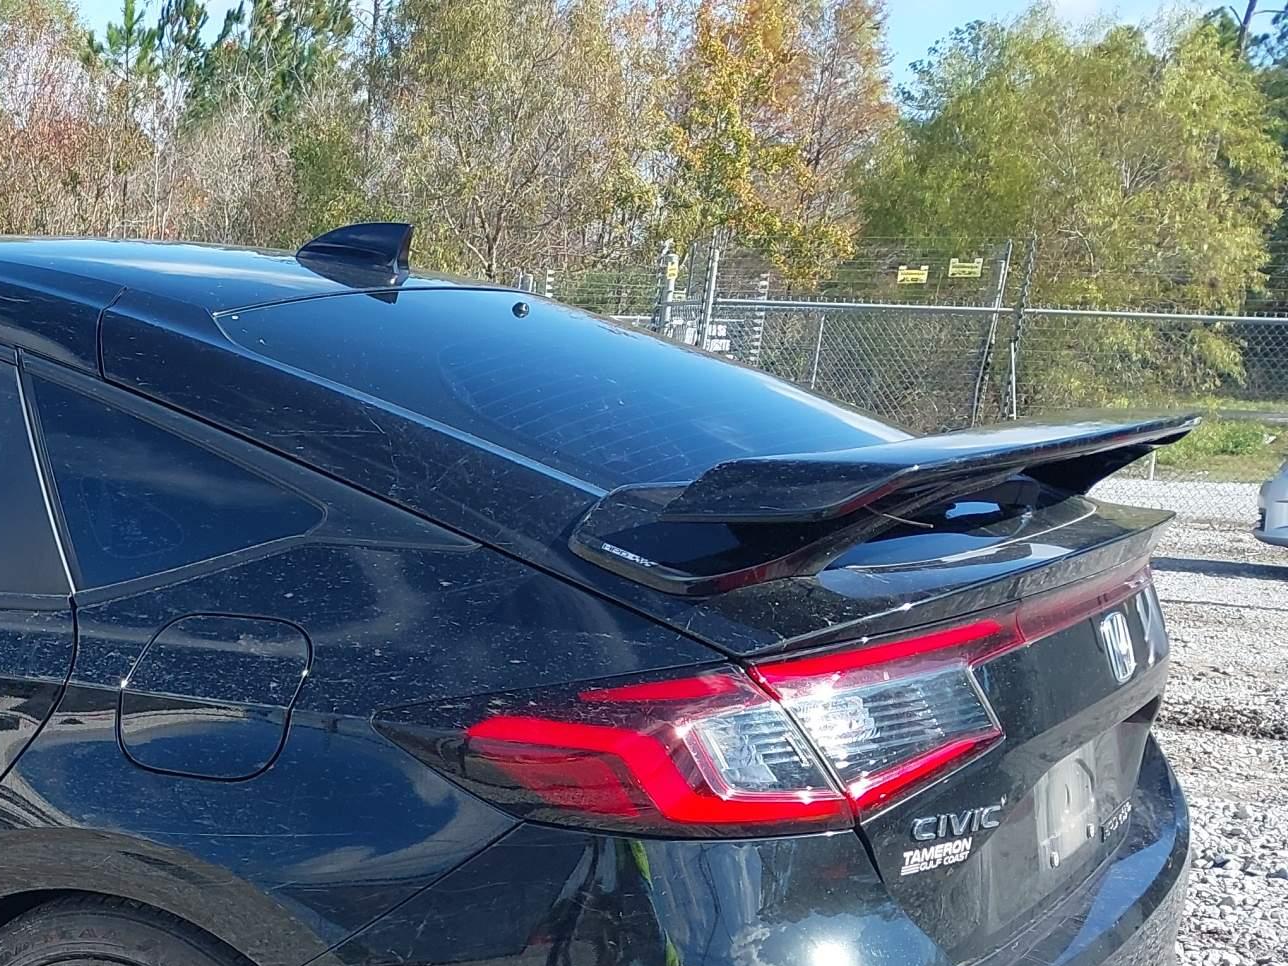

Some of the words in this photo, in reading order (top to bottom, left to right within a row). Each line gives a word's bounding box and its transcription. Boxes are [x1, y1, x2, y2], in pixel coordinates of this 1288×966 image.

[912, 805, 1002, 841] CIVIC
[902, 837, 973, 866] TAMERON
[919, 859, 942, 872] GULF
[943, 850, 970, 865] COAST
